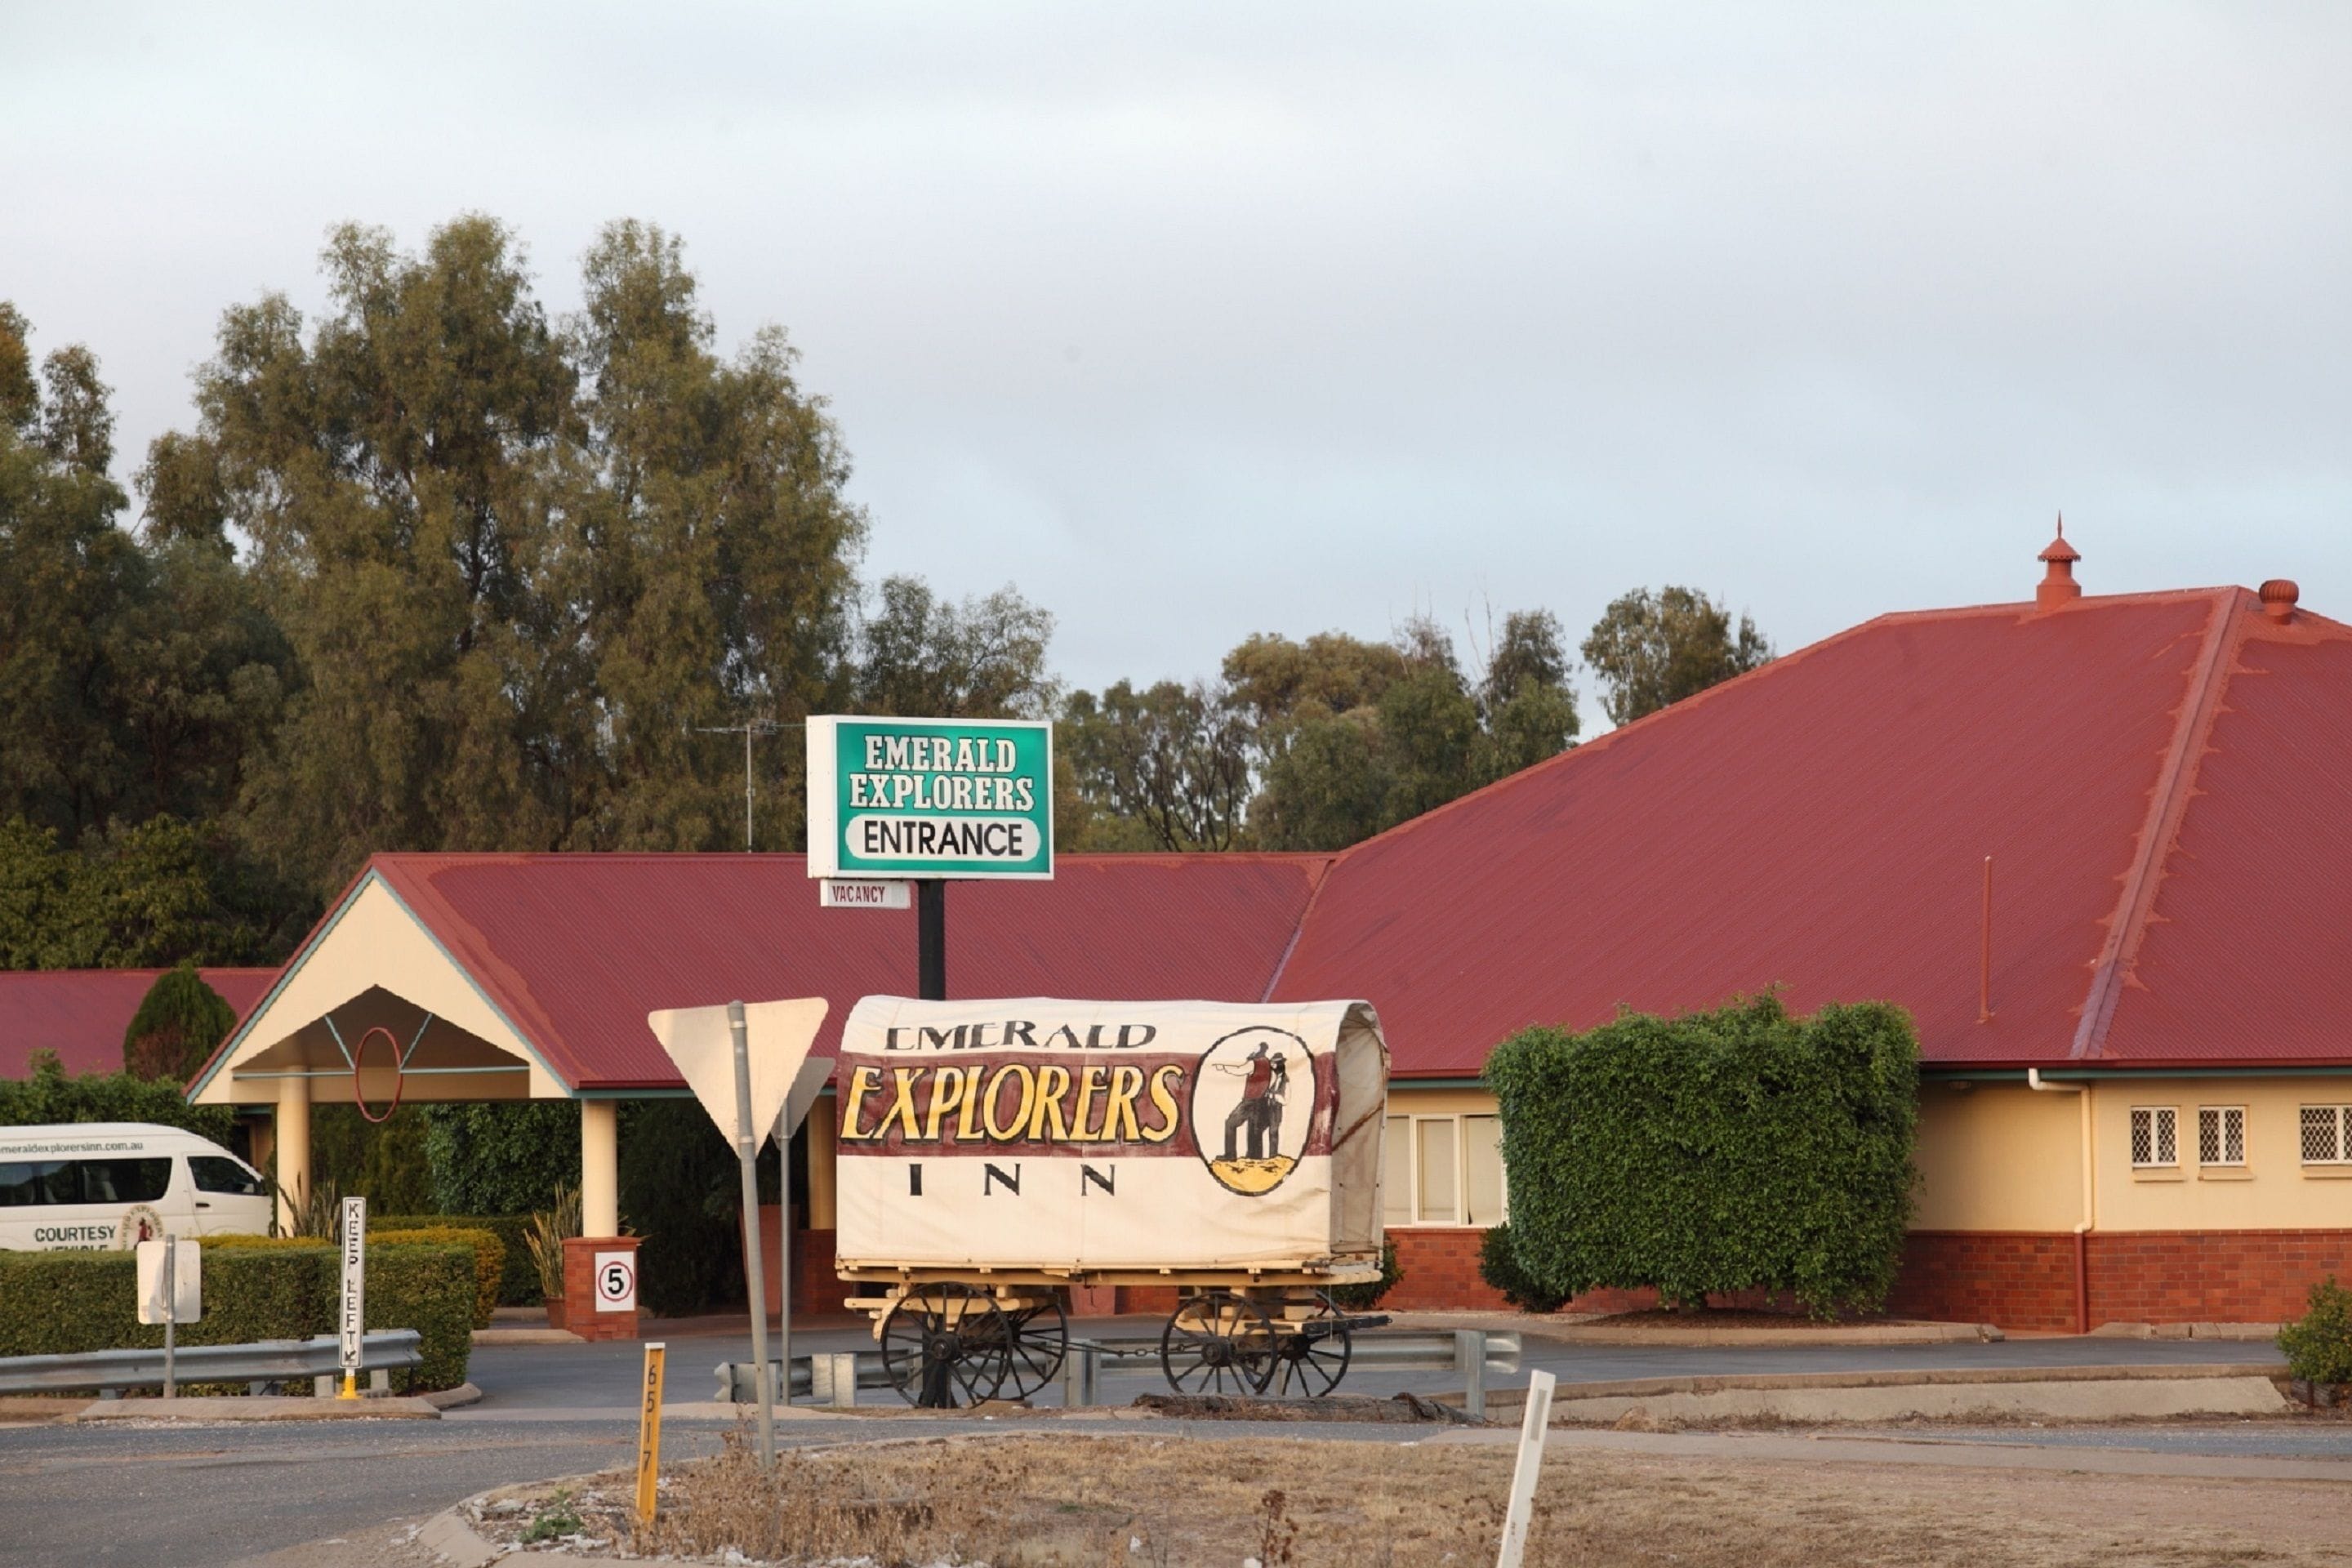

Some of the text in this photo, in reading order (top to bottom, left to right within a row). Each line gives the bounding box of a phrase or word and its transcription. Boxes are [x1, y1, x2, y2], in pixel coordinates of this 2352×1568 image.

[864, 734, 1018, 773] EMERALD
[849, 773, 1036, 812] EXPLORERS
[864, 820, 1022, 857] ENTRANCE
[832, 885, 886, 903] VACANCY
[884, 1020, 1157, 1052] EMERALD
[839, 1062, 1187, 1144] EXPLORERS
[0, 1142, 145, 1155] meraldexplorersinn.com.au
[909, 1163, 1116, 1196] INN
[34, 1225, 117, 1242] COURTESY
[345, 1202, 360, 1345] KEEP LEFT
[607, 1267, 625, 1295] 5
